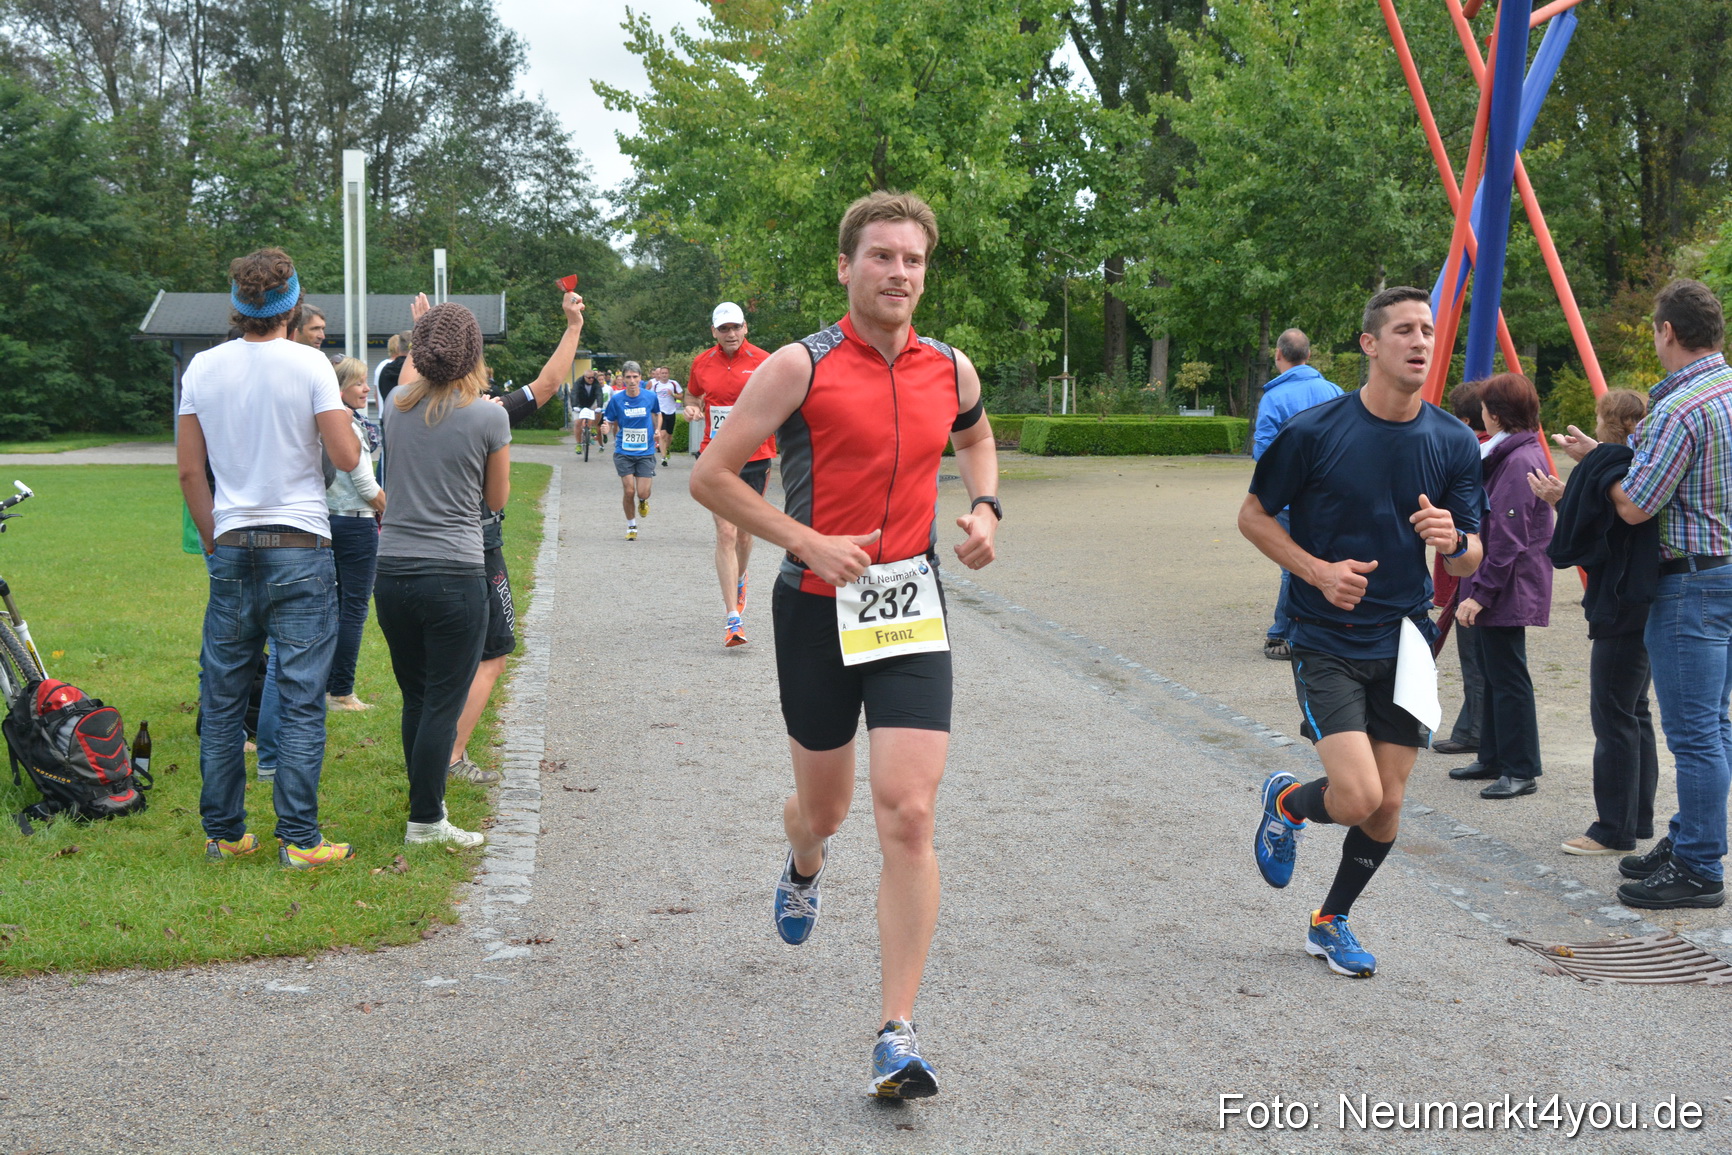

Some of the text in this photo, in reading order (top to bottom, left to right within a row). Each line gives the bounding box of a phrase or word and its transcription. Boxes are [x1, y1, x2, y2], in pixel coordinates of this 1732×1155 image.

[625, 433, 646, 443] 2870
[877, 567, 919, 584] Neumark
[858, 581, 921, 623] 232
[875, 628, 915, 644] Franz
